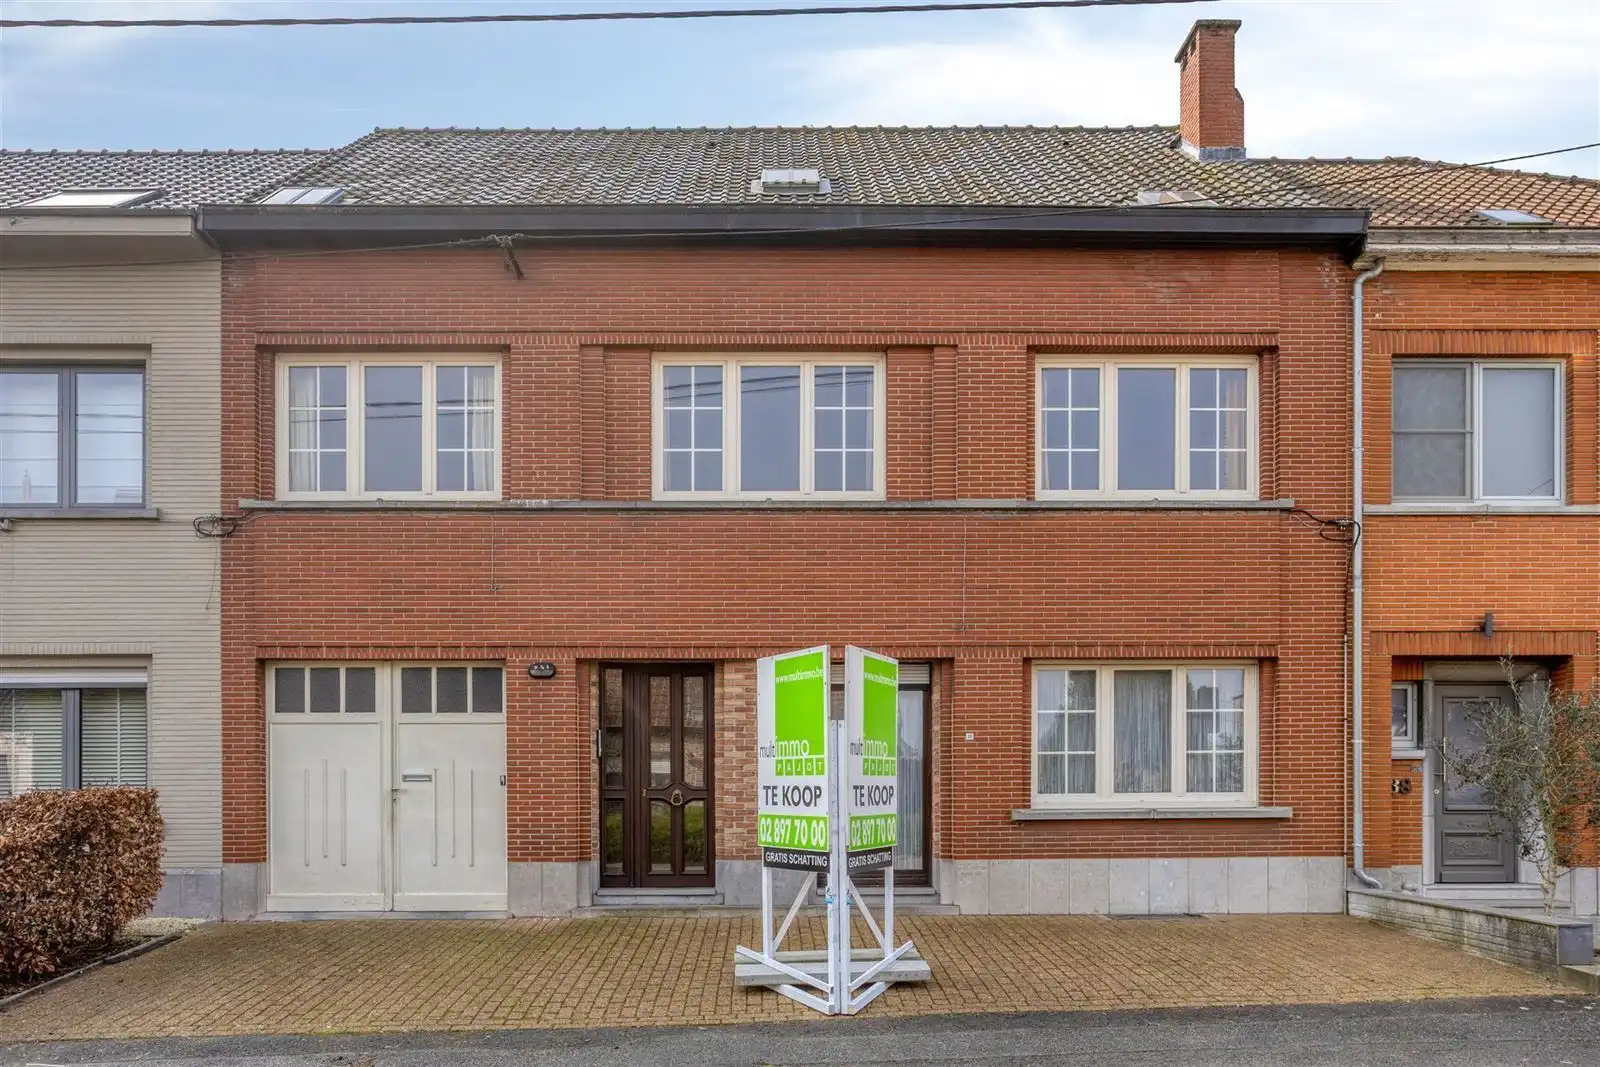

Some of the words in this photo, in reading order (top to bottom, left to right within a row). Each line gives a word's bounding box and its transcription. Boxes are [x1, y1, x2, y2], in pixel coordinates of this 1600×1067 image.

[776, 761, 824, 773] PAJOT
[763, 785, 778, 806] TE
[782, 785, 822, 807] KOOP
[853, 785, 865, 806] TE
[868, 785, 894, 806] KOOP
[760, 817, 772, 842] 02
[774, 819, 792, 844] 897
[794, 820, 808, 846] 70
[811, 820, 826, 847] 00
[851, 820, 862, 846] 02
[863, 819, 875, 846] 897
[876, 818, 886, 842] 70
[887, 816, 896, 841] 00
[765, 852, 788, 863] GRATIS
[788, 853, 828, 867] SCHATTING
[848, 855, 867, 867] GRATIS
[867, 851, 892, 864] SCHATTING
